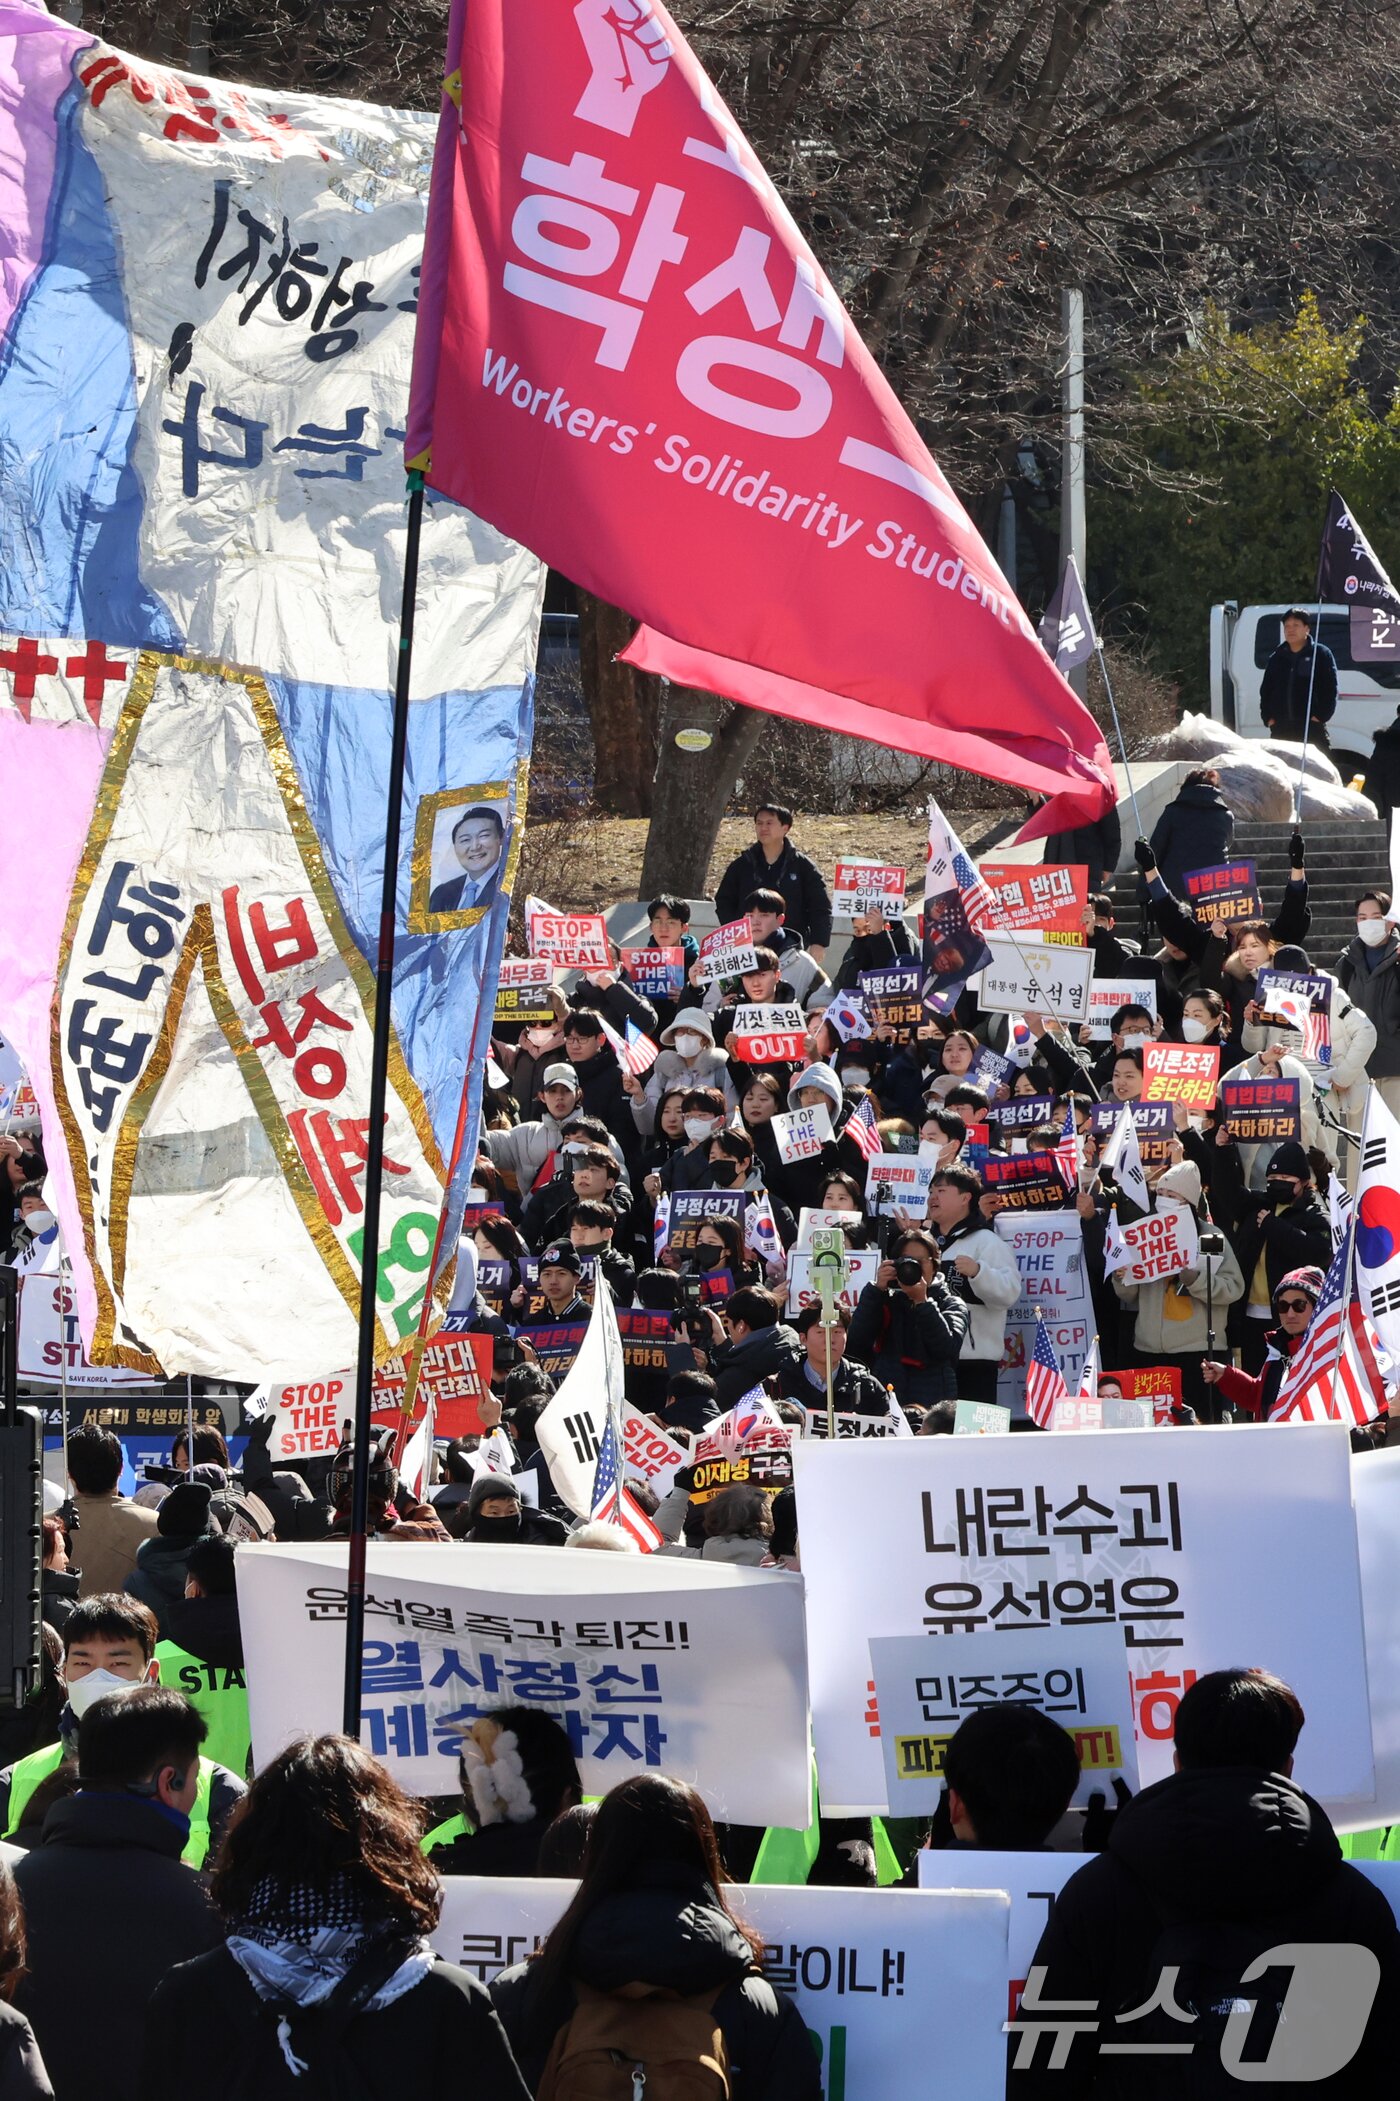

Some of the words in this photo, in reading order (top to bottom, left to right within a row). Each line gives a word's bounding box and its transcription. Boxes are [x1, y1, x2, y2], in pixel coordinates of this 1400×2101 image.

[481, 350, 656, 456] Workers'
[654, 433, 865, 550] Solidarity
[866, 518, 1011, 626] Student
[840, 868, 902, 888] 부정선거
[1028, 869, 1073, 903] 반대
[1188, 866, 1249, 895] 불법탄핵
[856, 886, 882, 897] OUT
[837, 898, 900, 917] 국회해산
[1195, 897, 1255, 924] 각하하라
[542, 920, 592, 938] STOP
[702, 922, 749, 952] 부정선거
[537, 948, 604, 964] STEAL
[560, 940, 578, 948] THE
[712, 945, 743, 959] OUT
[631, 951, 671, 964] STOP
[703, 952, 754, 979] 국회해산
[636, 966, 667, 978] THE
[862, 972, 919, 996] 부정선거
[520, 988, 548, 1006] 구속
[987, 980, 1018, 993] 대통령
[750, 1035, 798, 1061] OUT
[1146, 1048, 1216, 1078] 여론조작
[1147, 1075, 1215, 1107] 중단하라
[1225, 1084, 1294, 1106] 불법탄핵
[780, 1109, 814, 1129] STOP
[1226, 1117, 1296, 1138] 각하하라
[787, 1123, 816, 1143] THE
[785, 1137, 826, 1160] STEAL
[870, 1167, 916, 1184] 탄핵반대
[984, 1155, 1053, 1182] 불법탄핵
[674, 1197, 740, 1218] 부정선거
[1013, 1231, 1065, 1250] STOP
[1124, 1214, 1178, 1246] STOP
[1137, 1233, 1178, 1261] THE
[1016, 1254, 1055, 1272] THE
[1132, 1249, 1189, 1280] STEAL
[1021, 1277, 1067, 1296] EAL
[420, 1340, 477, 1379] 반대
[69, 1375, 86, 1383] SAVE
[87, 1376, 108, 1384] KOREA
[436, 1373, 482, 1400] 단죄!
[1133, 1372, 1173, 1395] 불법구속
[279, 1380, 343, 1408] STOP
[83, 1408, 129, 1426] 서울대
[136, 1408, 199, 1426] 학생회관
[205, 1408, 221, 1425] 앞
[290, 1405, 337, 1430] THE
[811, 1414, 897, 1439] 부정선
[281, 1428, 340, 1454] STEA
[624, 1418, 682, 1467] STOP
[693, 1456, 750, 1489] 이재명
[751, 1455, 792, 1480] 구속
[920, 1481, 1184, 1557] 내란수괴
[304, 1586, 456, 1635] 윤석열
[464, 1611, 565, 1648] 즉각
[575, 1620, 690, 1650] 퇴진!
[361, 1640, 663, 1704] 열사정신
[915, 1667, 1087, 1722] 민주주의
